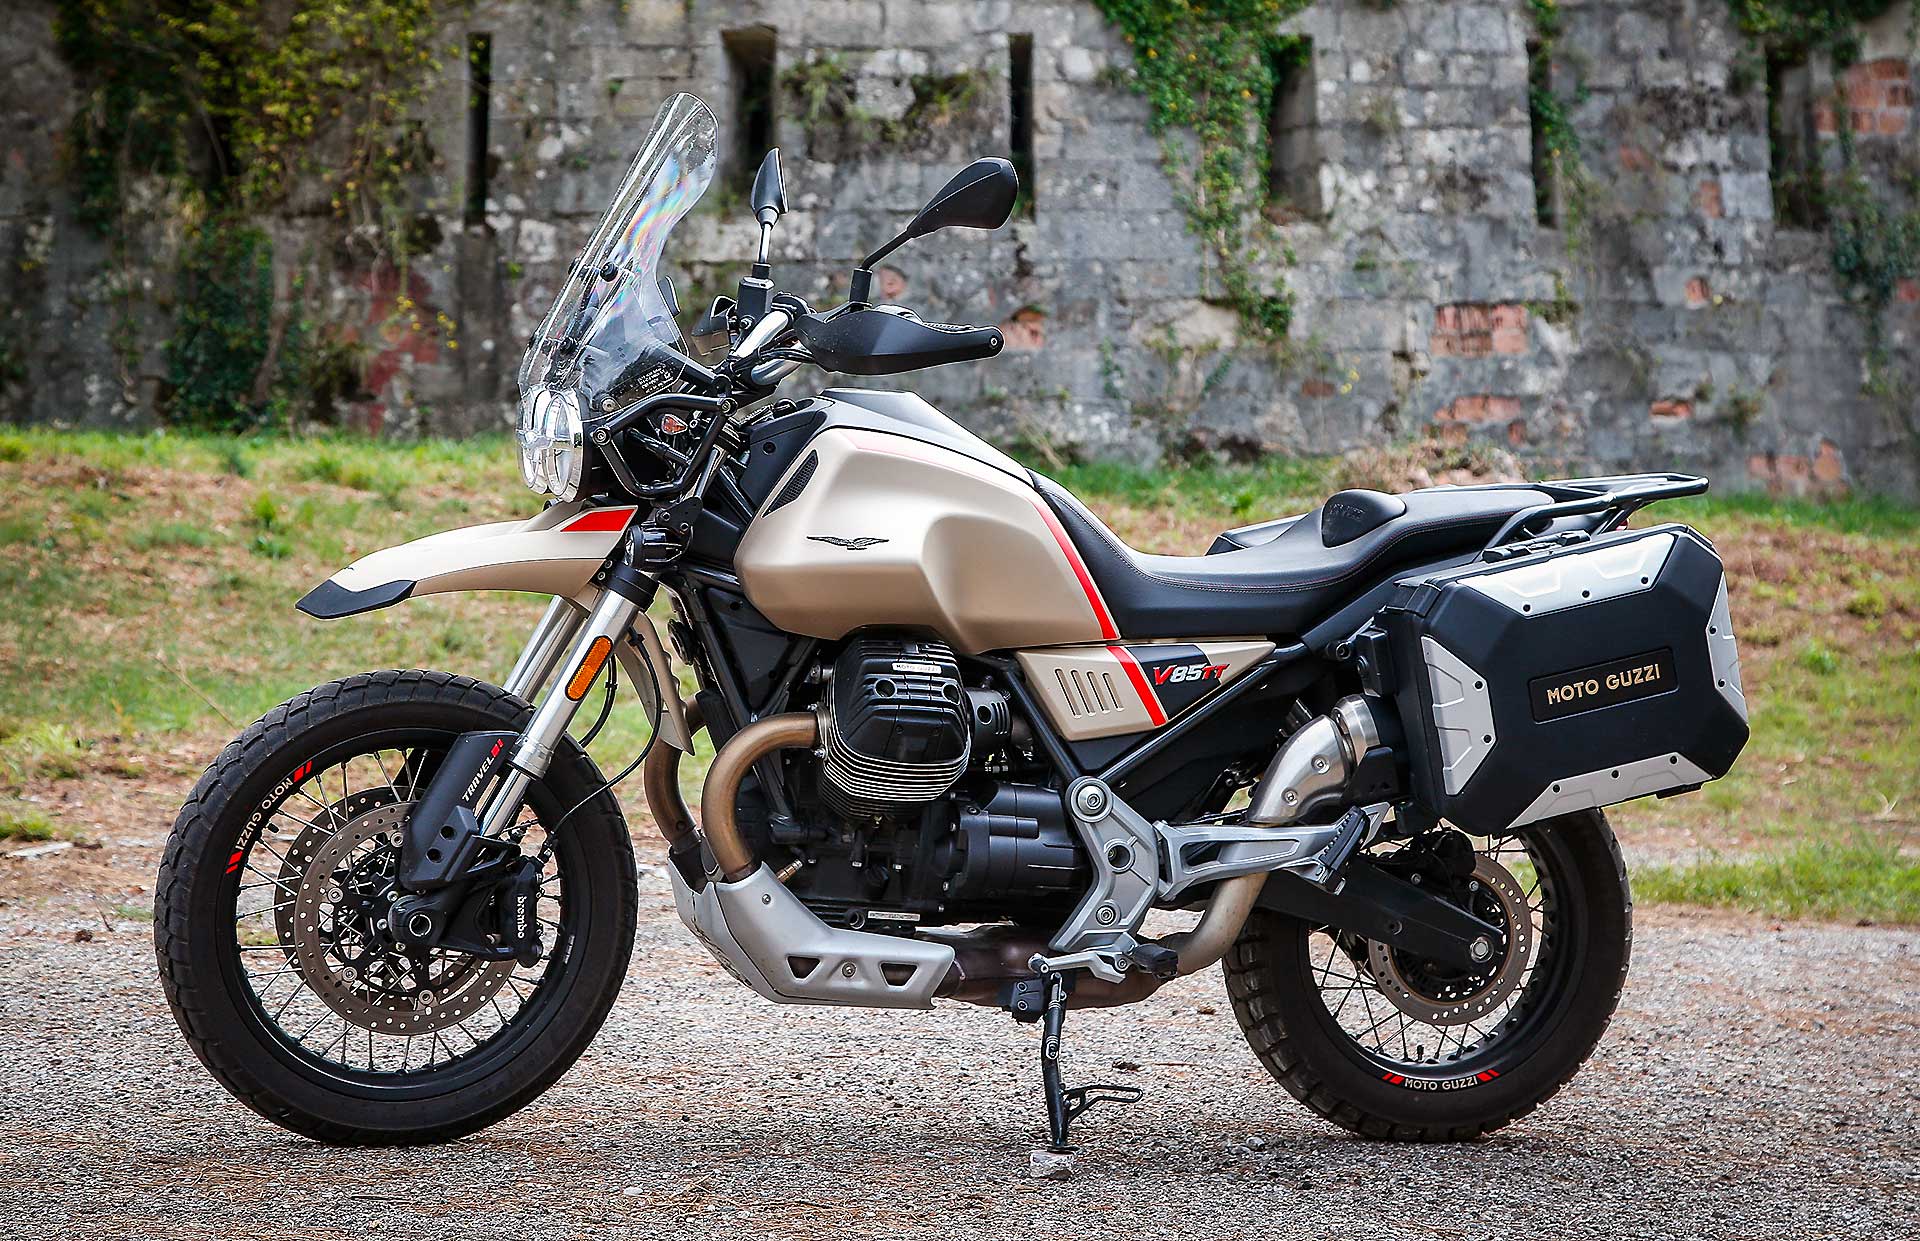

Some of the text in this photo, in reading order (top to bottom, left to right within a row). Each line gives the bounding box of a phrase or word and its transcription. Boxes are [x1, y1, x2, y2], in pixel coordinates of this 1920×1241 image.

[1153, 663, 1229, 685] V85TT
[1546, 663, 1660, 705] MOTO GUZZI
[462, 756, 495, 802] TRAVEL
[235, 777, 294, 850] MOTO GUZZI
[516, 895, 528, 939] brembo
[1404, 1075, 1478, 1091] MOTO GUZZI
